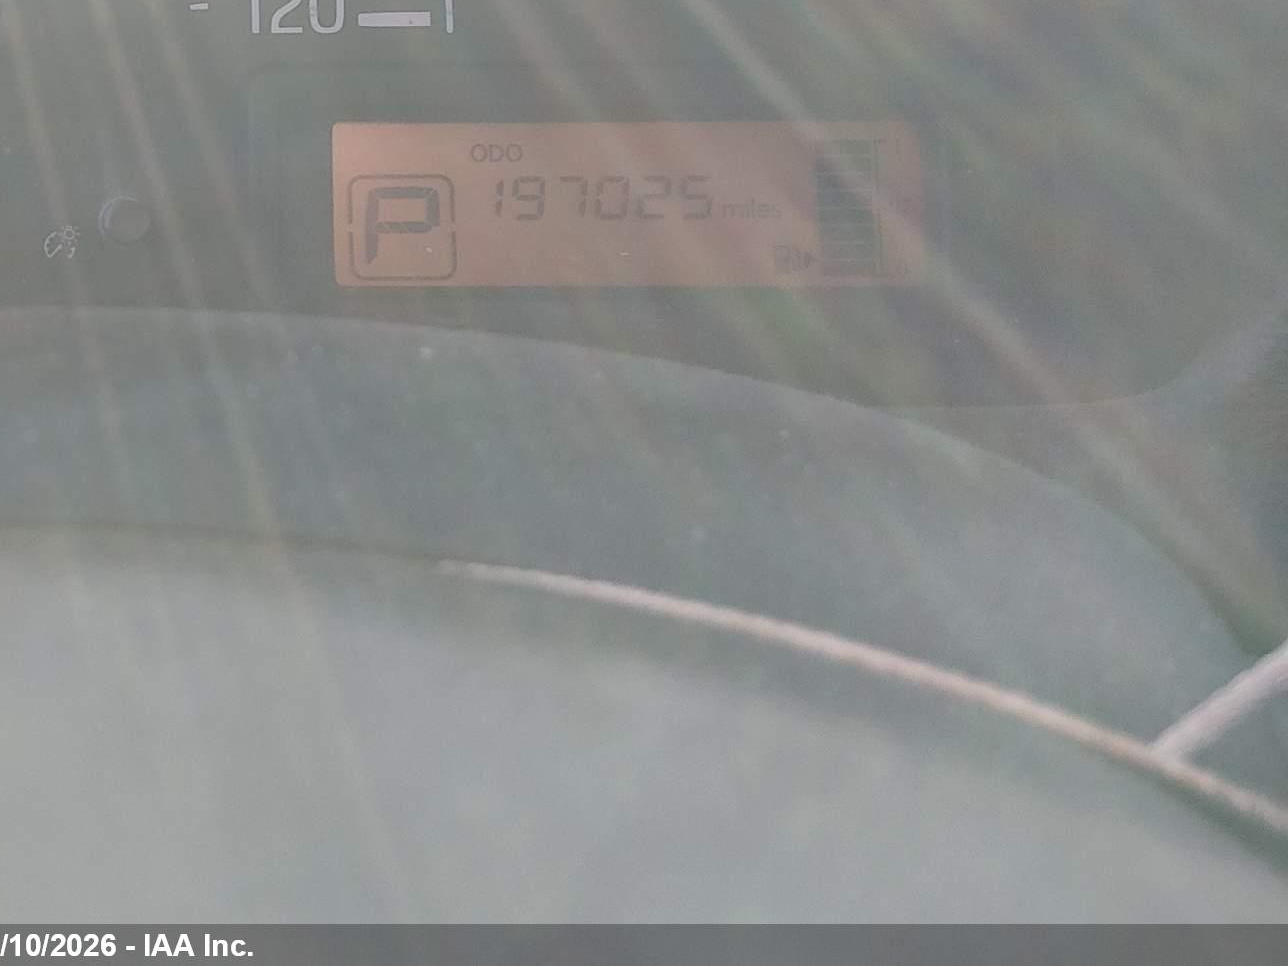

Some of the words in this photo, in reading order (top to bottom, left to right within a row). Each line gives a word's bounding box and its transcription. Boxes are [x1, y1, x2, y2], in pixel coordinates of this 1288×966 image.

[470, 144, 523, 163] ODO
[492, 175, 712, 221] 197025
[722, 195, 781, 219] miles
[366, 186, 440, 265] P
